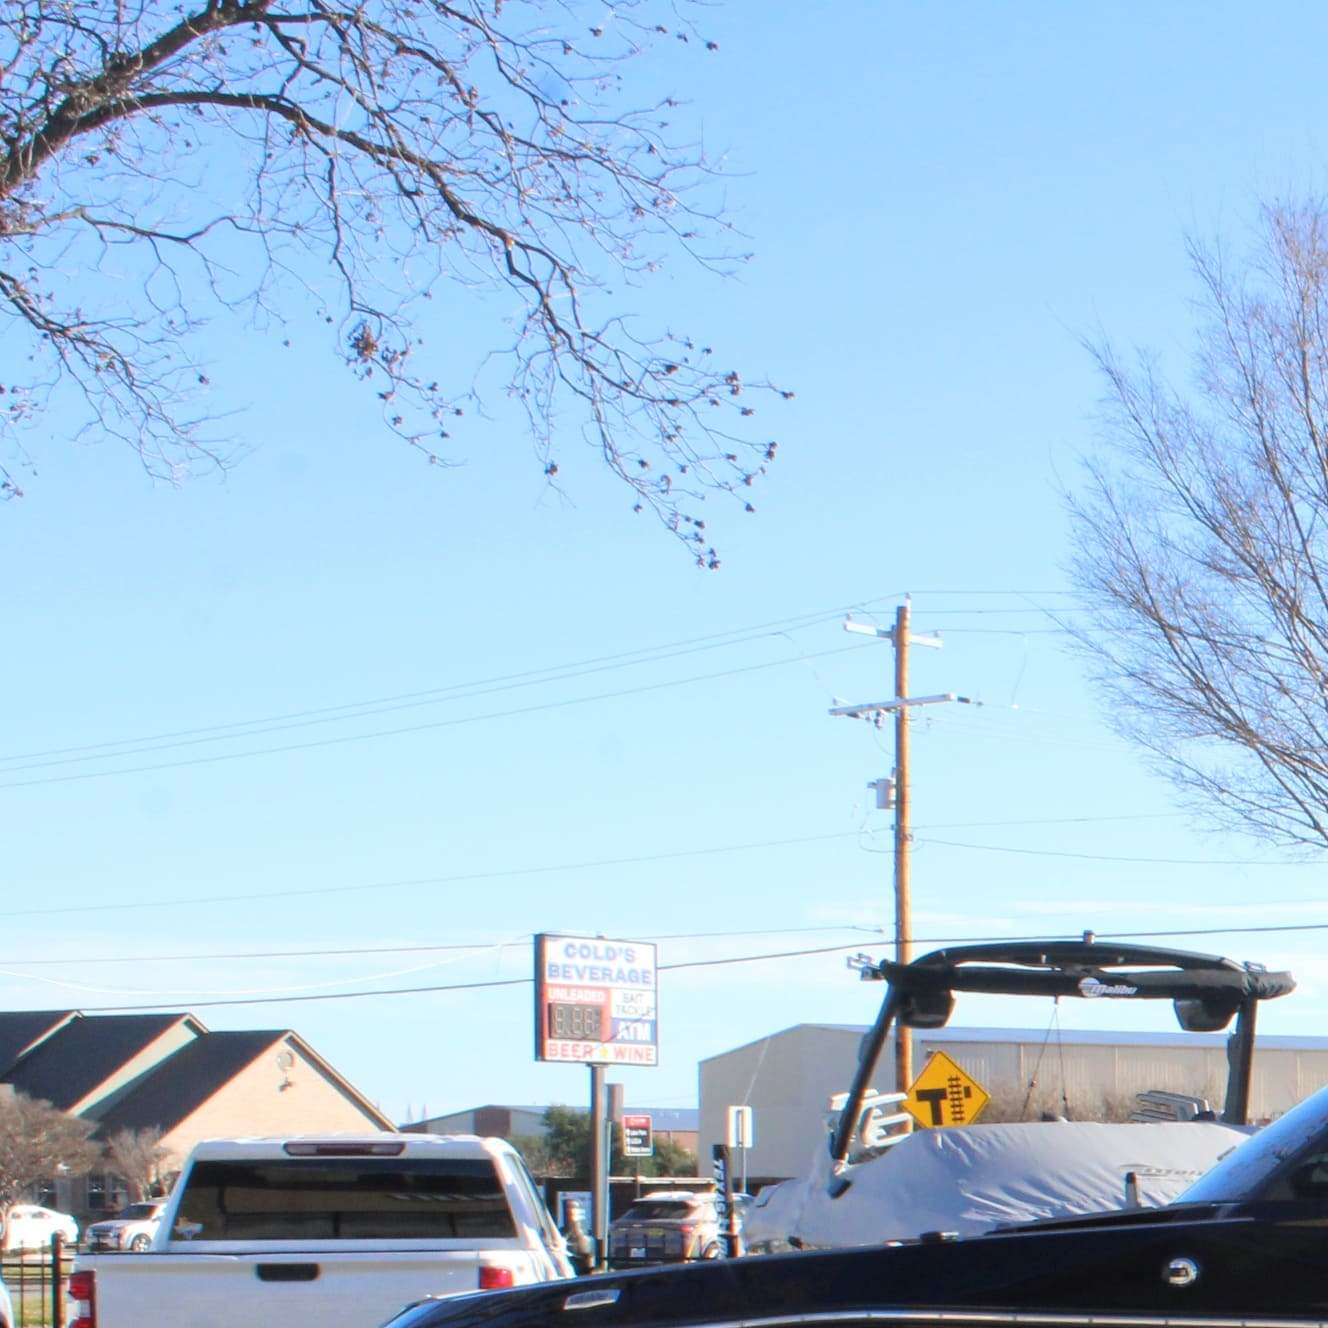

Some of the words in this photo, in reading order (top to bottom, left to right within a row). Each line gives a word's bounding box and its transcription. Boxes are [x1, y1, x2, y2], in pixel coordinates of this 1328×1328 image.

[547, 964, 653, 985] BEVERAGE
[616, 1019, 652, 1041] ATM
[548, 1043, 594, 1058] BEER
[613, 1046, 655, 1061] WINE
